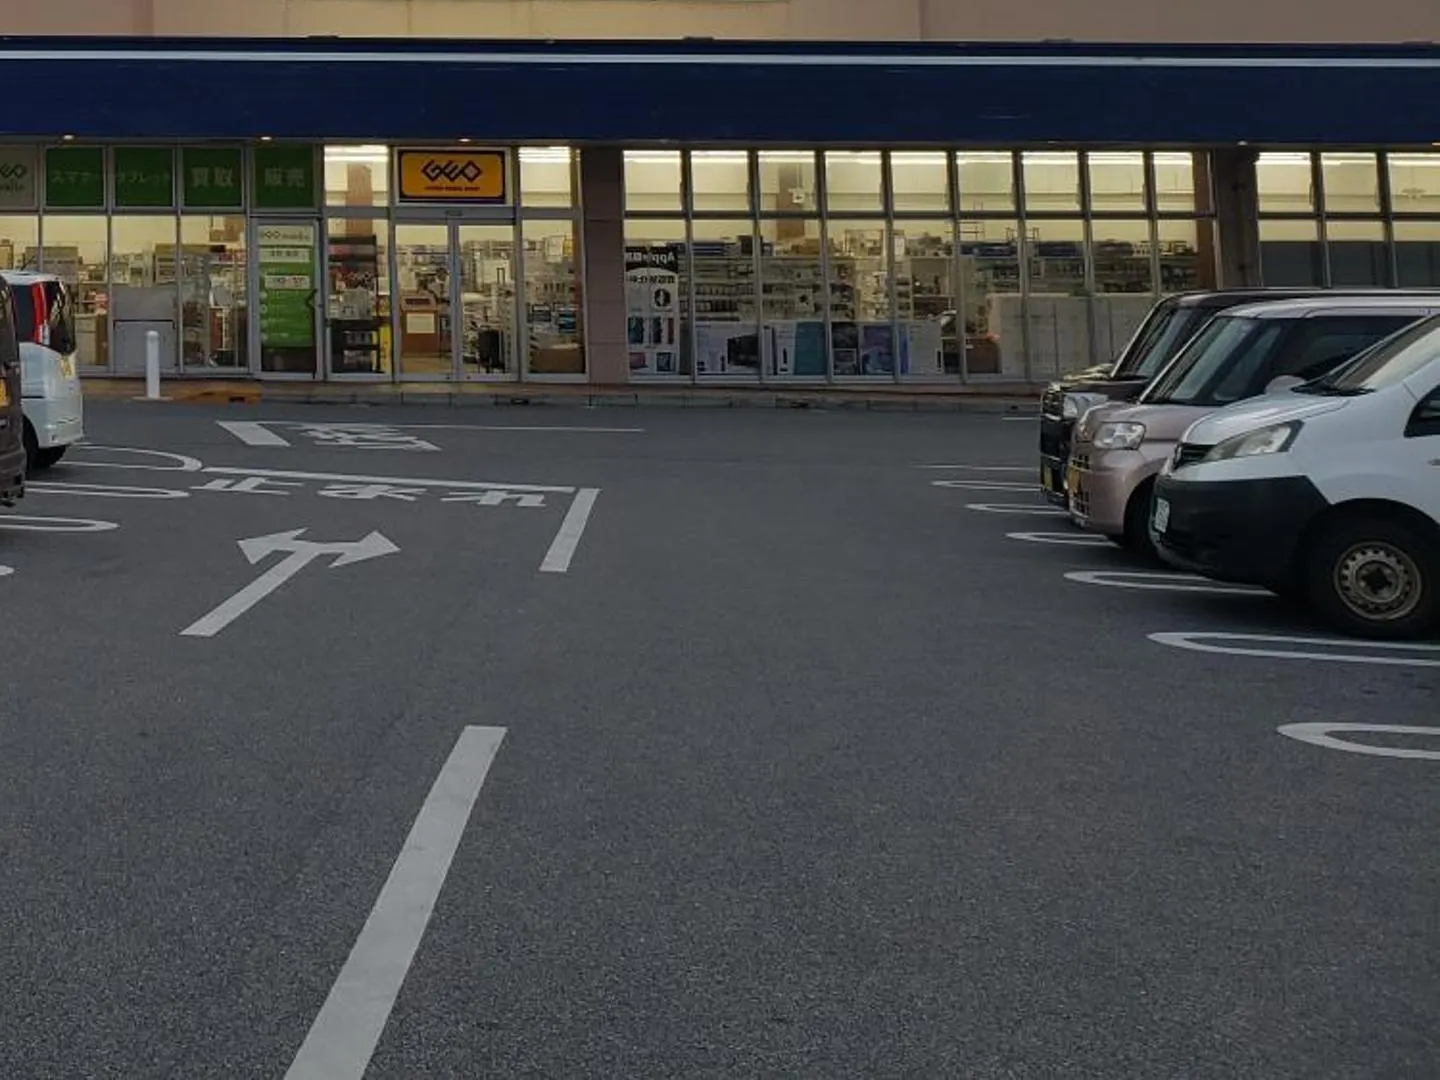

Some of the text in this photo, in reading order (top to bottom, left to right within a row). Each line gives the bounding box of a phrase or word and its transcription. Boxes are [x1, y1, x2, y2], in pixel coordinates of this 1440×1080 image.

[421, 159, 483, 183] GEO
[188, 476, 548, 508] 止まれ
